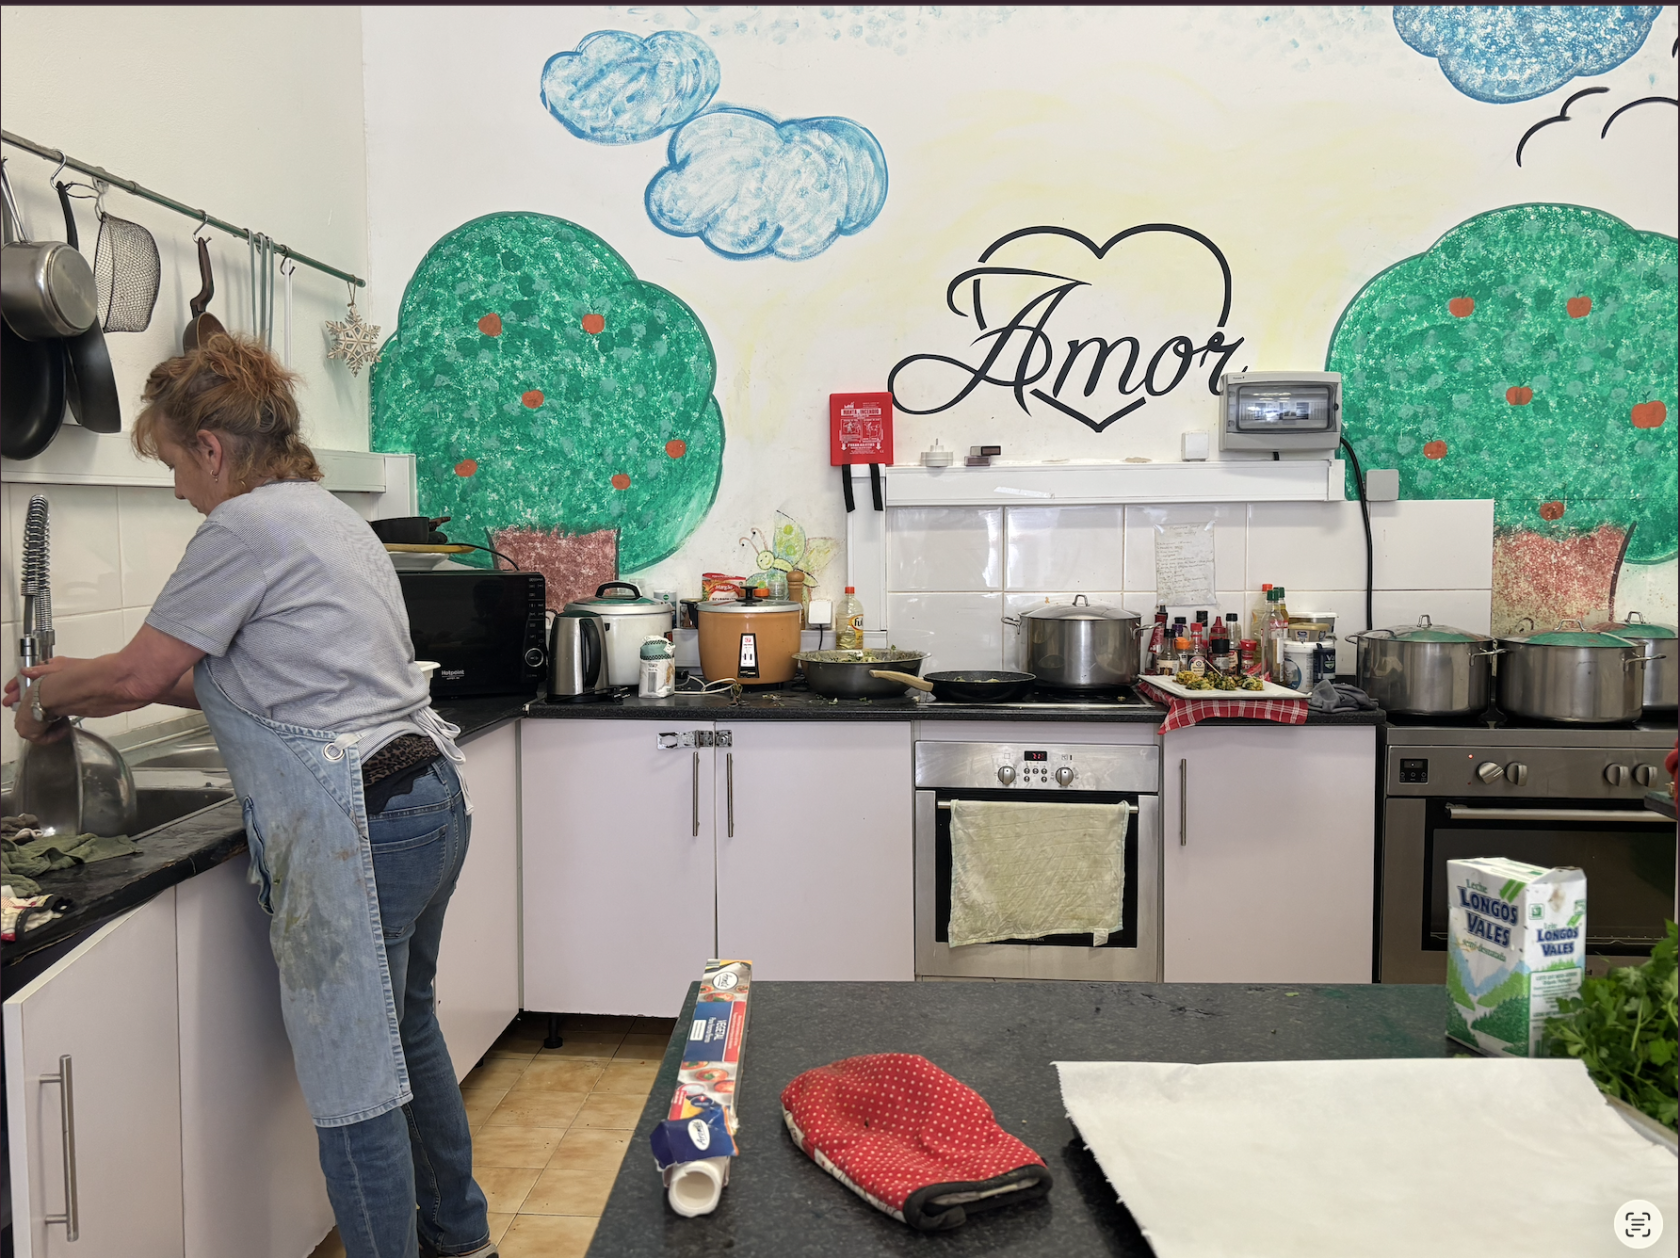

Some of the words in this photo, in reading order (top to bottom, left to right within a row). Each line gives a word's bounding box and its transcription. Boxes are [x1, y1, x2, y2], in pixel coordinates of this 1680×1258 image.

[888, 267, 1247, 417] Amor
[1456, 885, 1518, 926] LONGOS
[1465, 909, 1512, 948] VALES
[1536, 926, 1579, 943] LONGOS
[1540, 941, 1575, 957] VALES
[714, 1019, 728, 1041] VEGETAL
